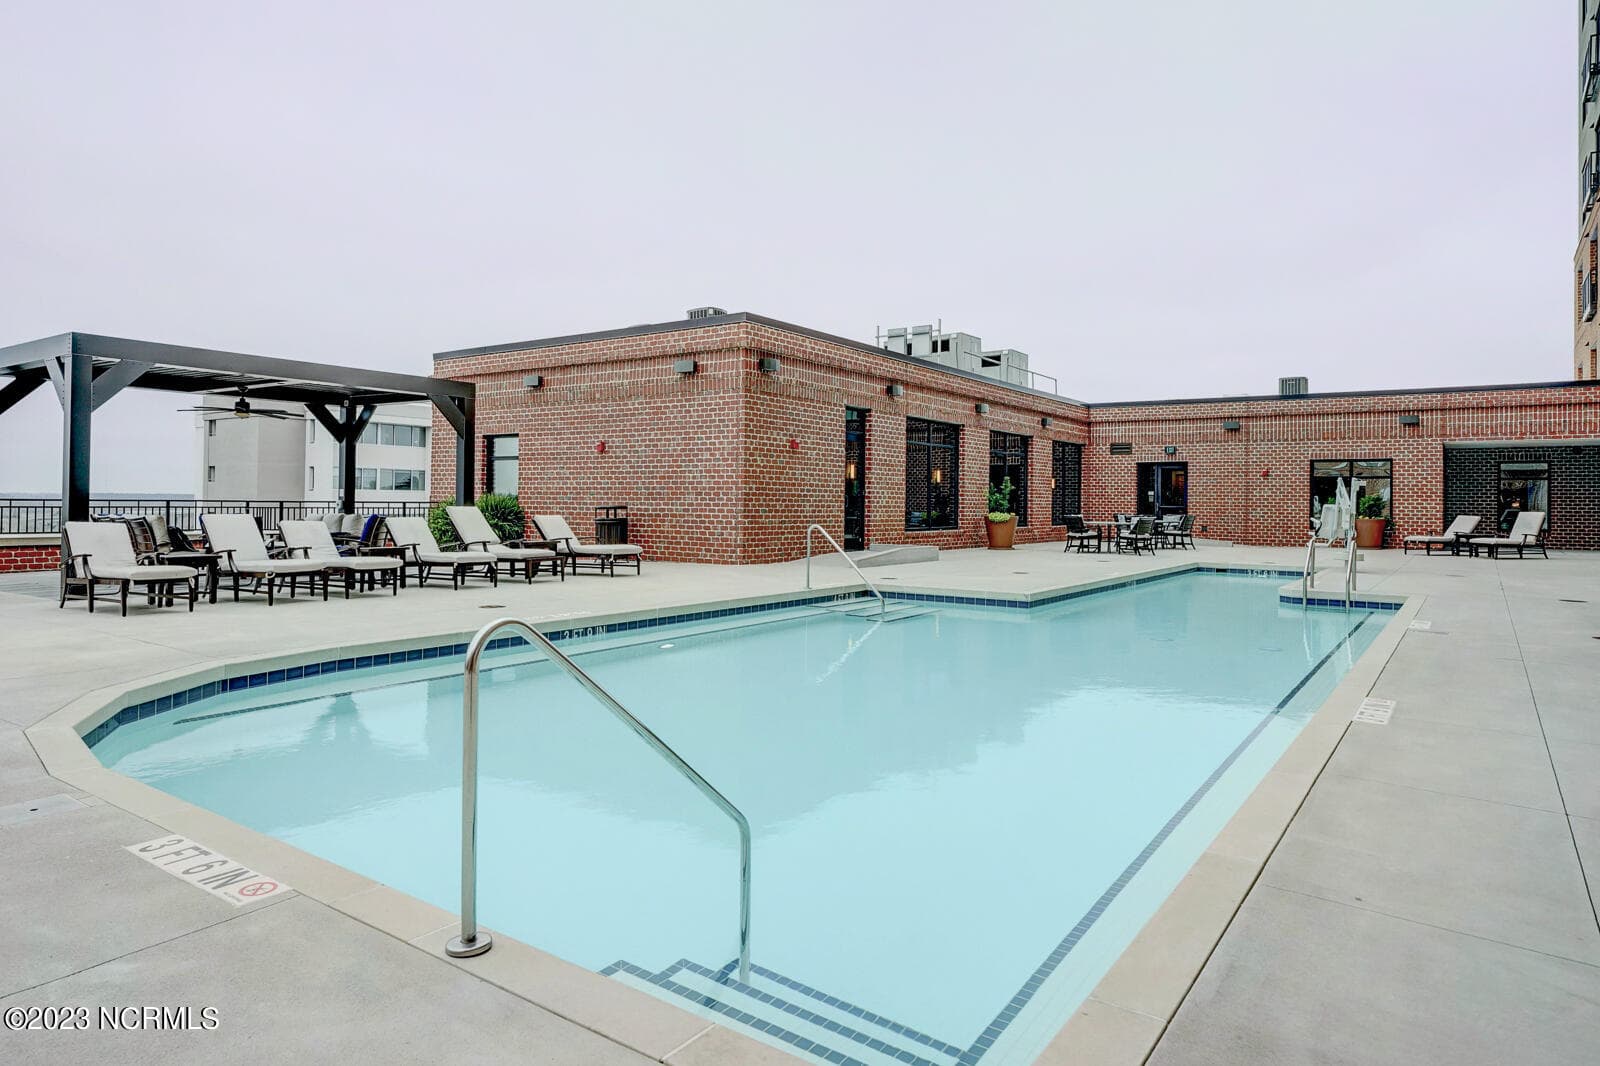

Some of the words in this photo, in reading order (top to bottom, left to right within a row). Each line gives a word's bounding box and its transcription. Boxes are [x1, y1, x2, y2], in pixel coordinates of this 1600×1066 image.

[138, 838, 185, 853] 3
[152, 845, 212, 866] FT
[182, 859, 229, 875] 6
[197, 867, 259, 890] IN
